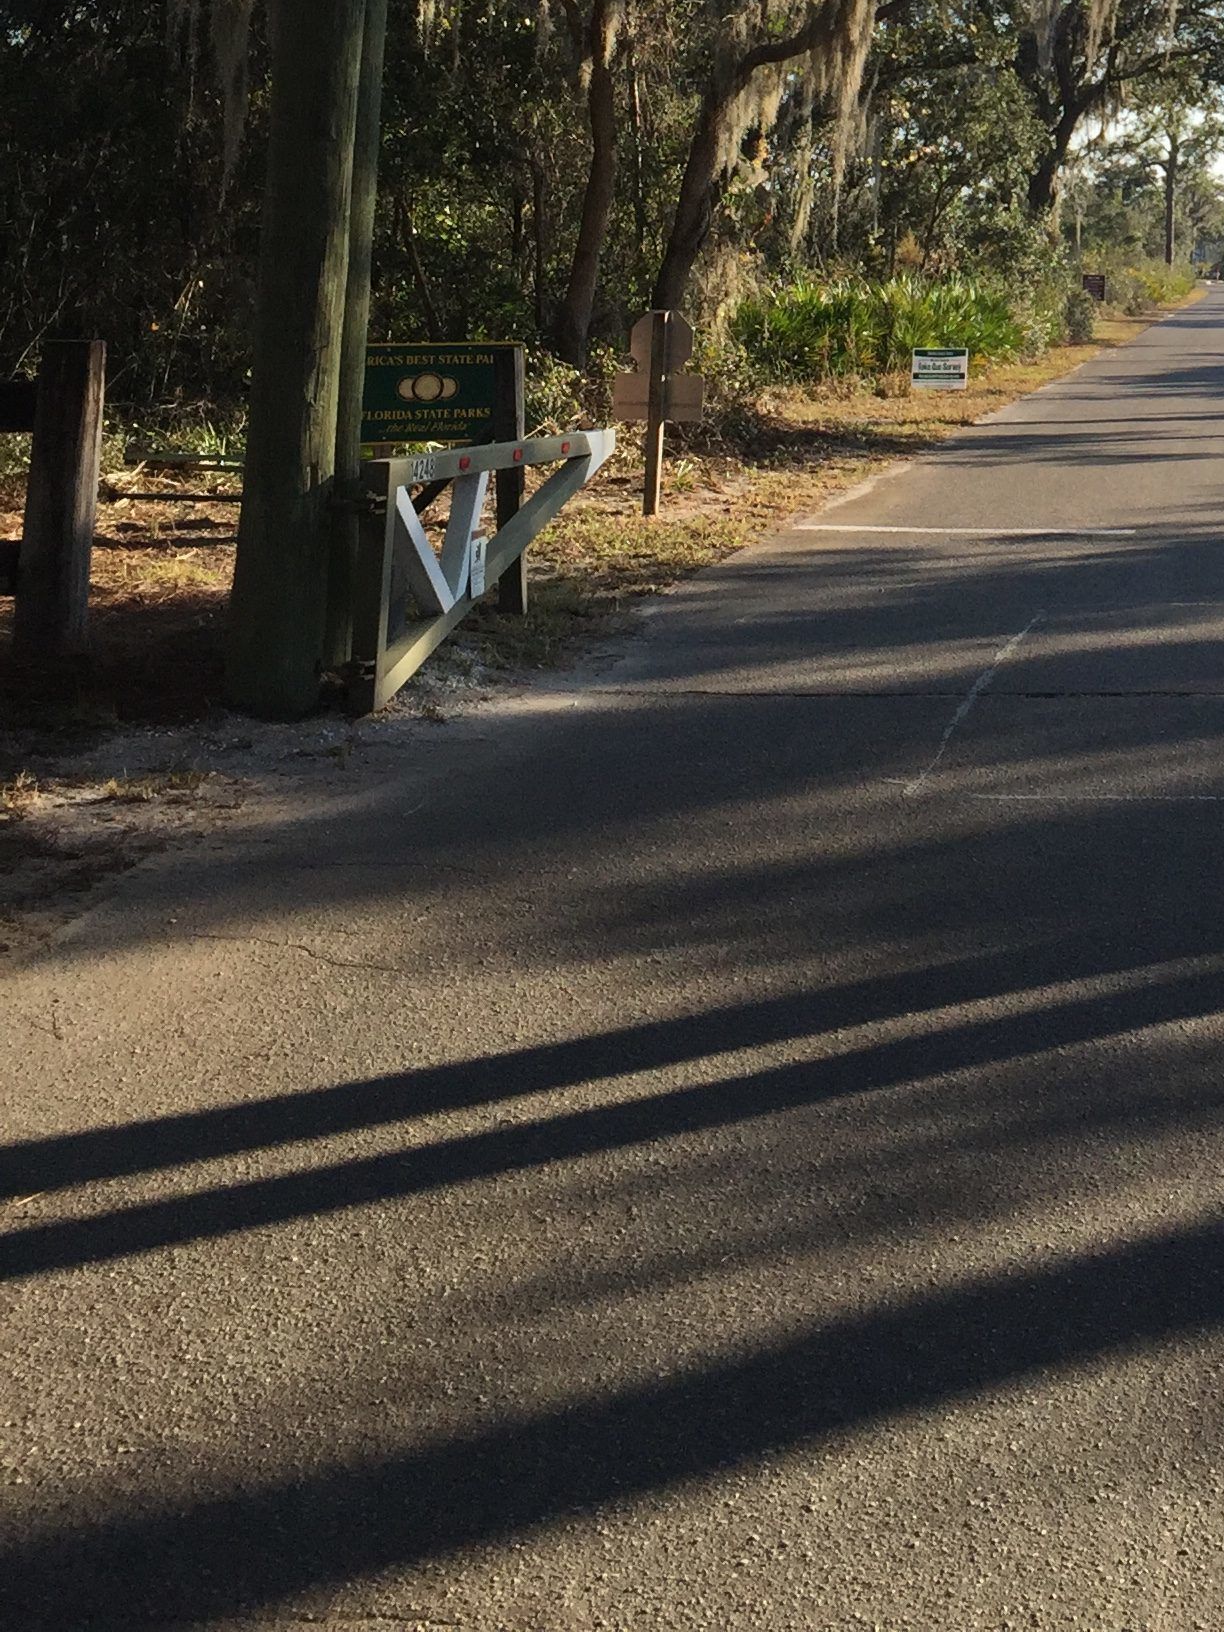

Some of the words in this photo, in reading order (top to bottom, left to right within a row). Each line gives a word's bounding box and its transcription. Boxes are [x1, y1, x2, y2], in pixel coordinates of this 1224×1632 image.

[406, 355, 435, 365] BEST
[438, 354, 473, 365] STATE
[362, 410, 412, 420] FLORIDA
[415, 409, 450, 419] STATE
[453, 408, 491, 418] PARKS
